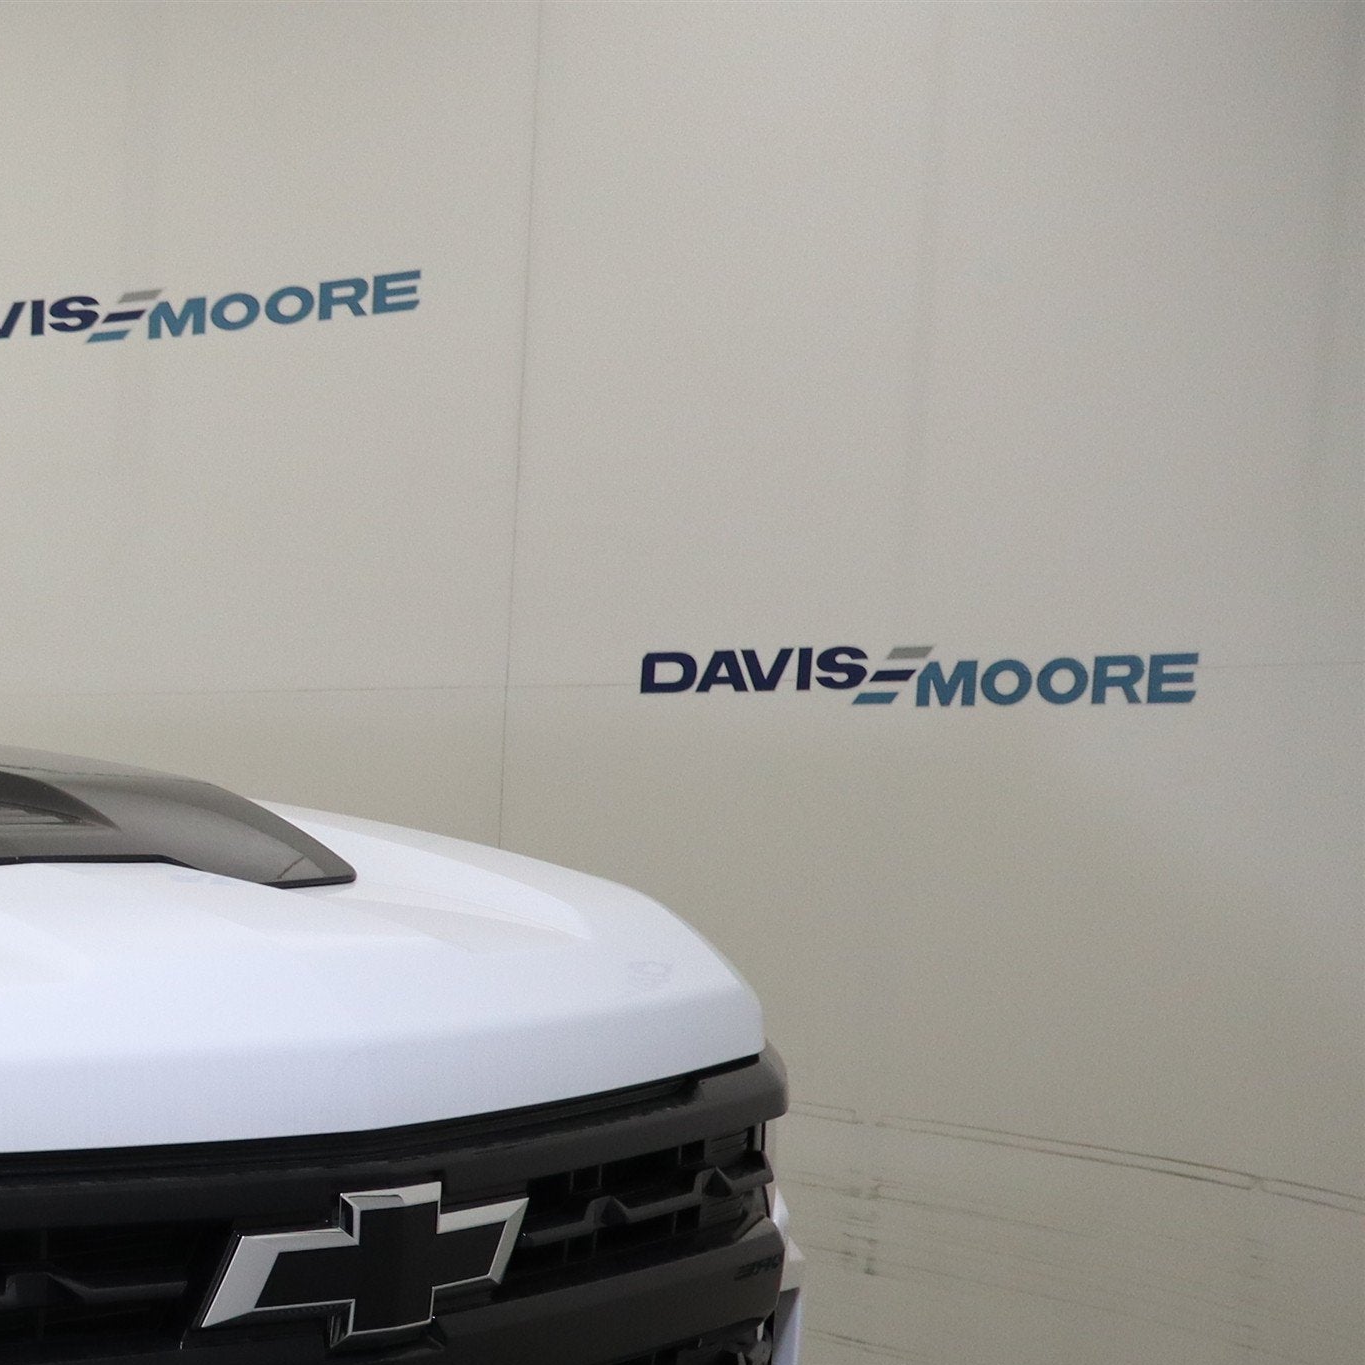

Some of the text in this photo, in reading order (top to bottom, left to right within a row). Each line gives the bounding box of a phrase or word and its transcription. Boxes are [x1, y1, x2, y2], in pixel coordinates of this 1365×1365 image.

[147, 269, 422, 340] MOORE
[639, 645, 1200, 708] DAVIS MOORE
